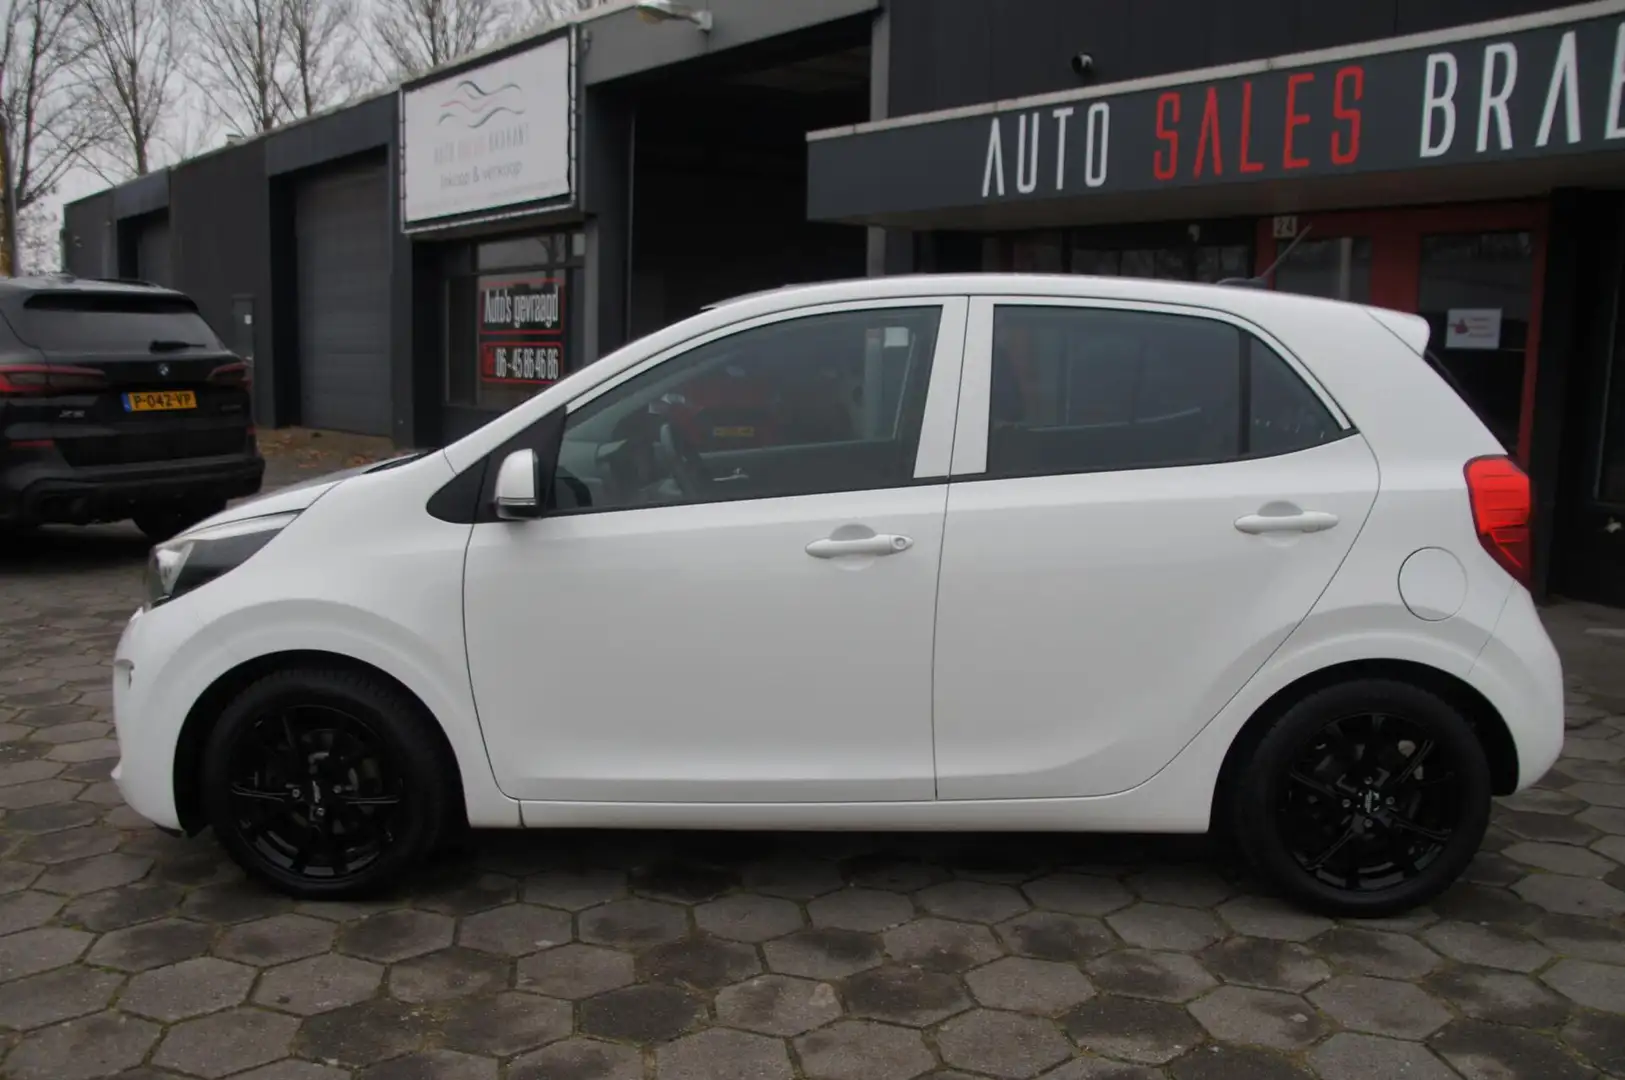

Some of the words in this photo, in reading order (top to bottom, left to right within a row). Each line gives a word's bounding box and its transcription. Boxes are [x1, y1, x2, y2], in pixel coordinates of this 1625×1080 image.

[982, 101, 1110, 197] AUTO
[1153, 65, 1364, 182] SALES
[483, 287, 512, 324] Auto's
[513, 284, 559, 329] gevraagd
[134, 394, 191, 409] P-042-VP
